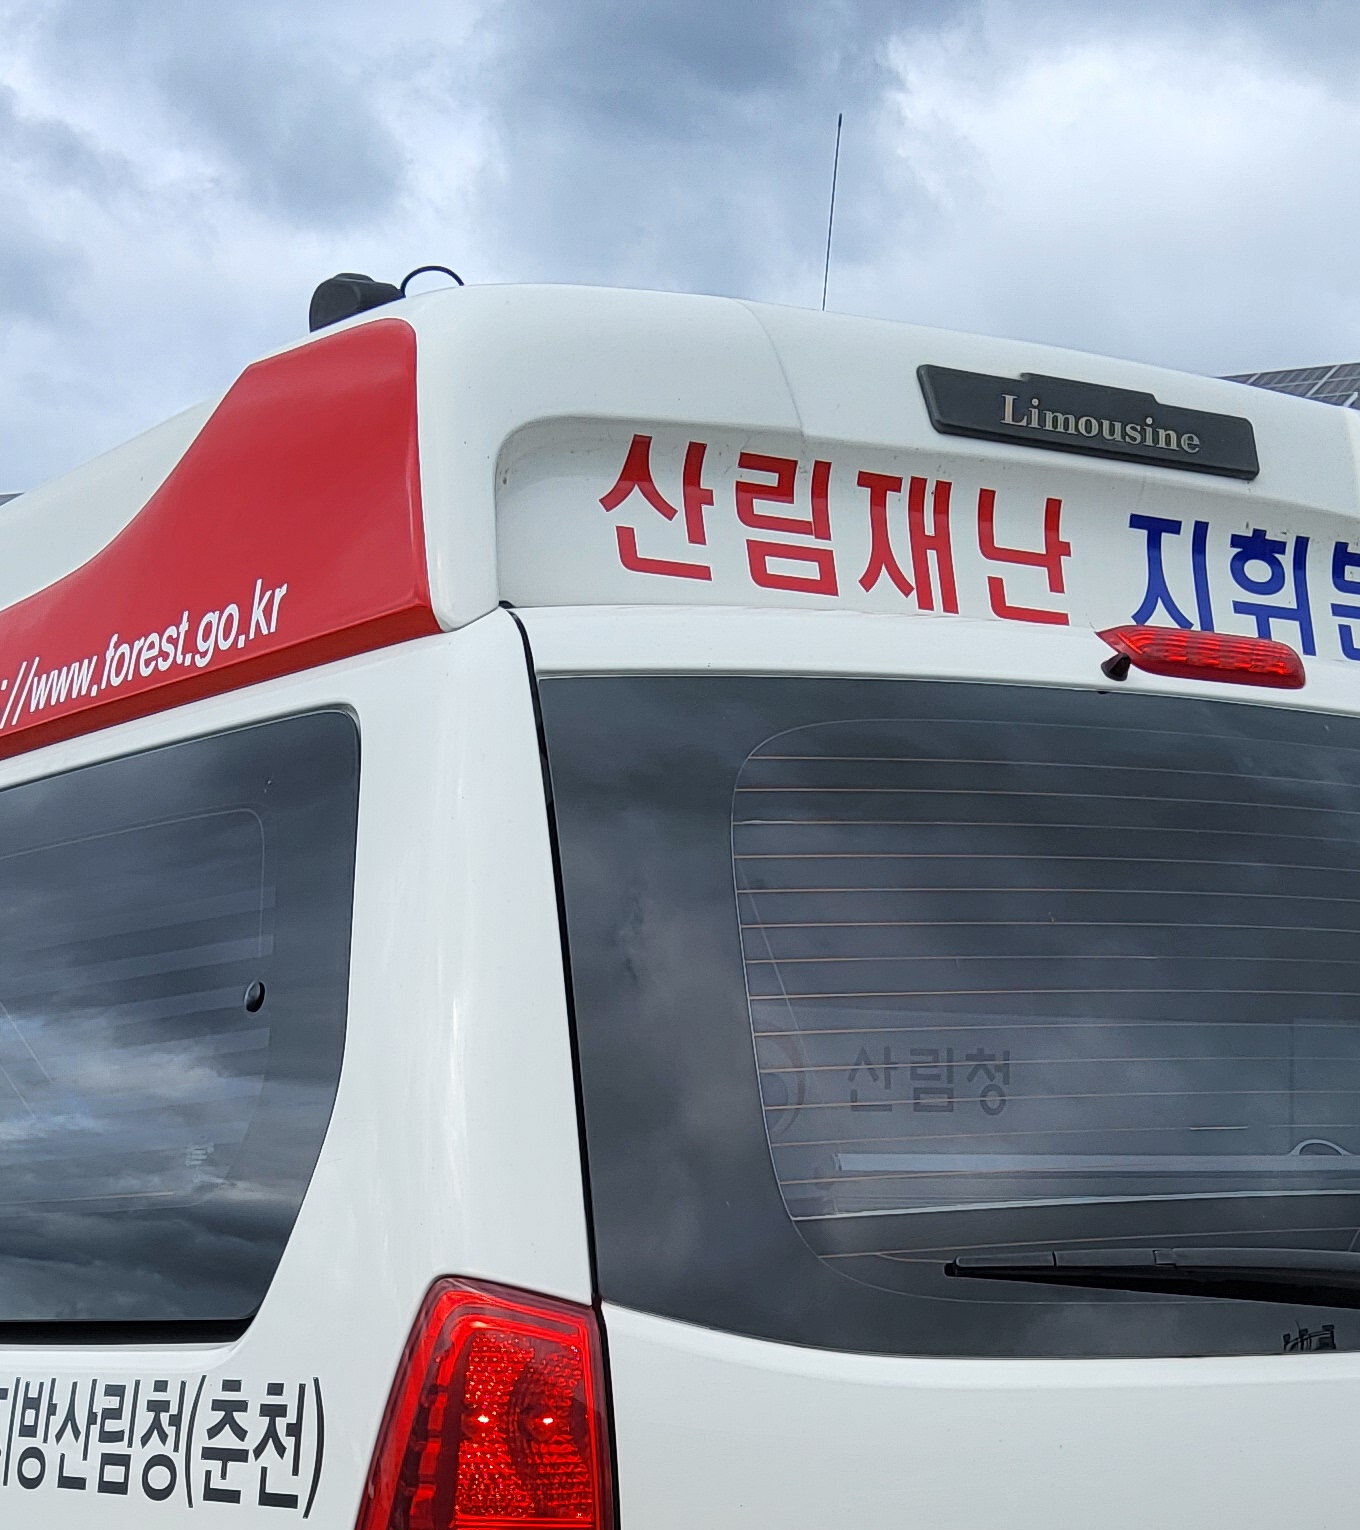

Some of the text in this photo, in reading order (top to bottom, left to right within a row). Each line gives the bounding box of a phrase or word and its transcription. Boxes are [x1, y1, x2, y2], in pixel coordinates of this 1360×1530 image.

[1000, 393, 1201, 454] Limousine
[598, 434, 1072, 627] 산림재난
[847, 1045, 1011, 1117] 산림청
